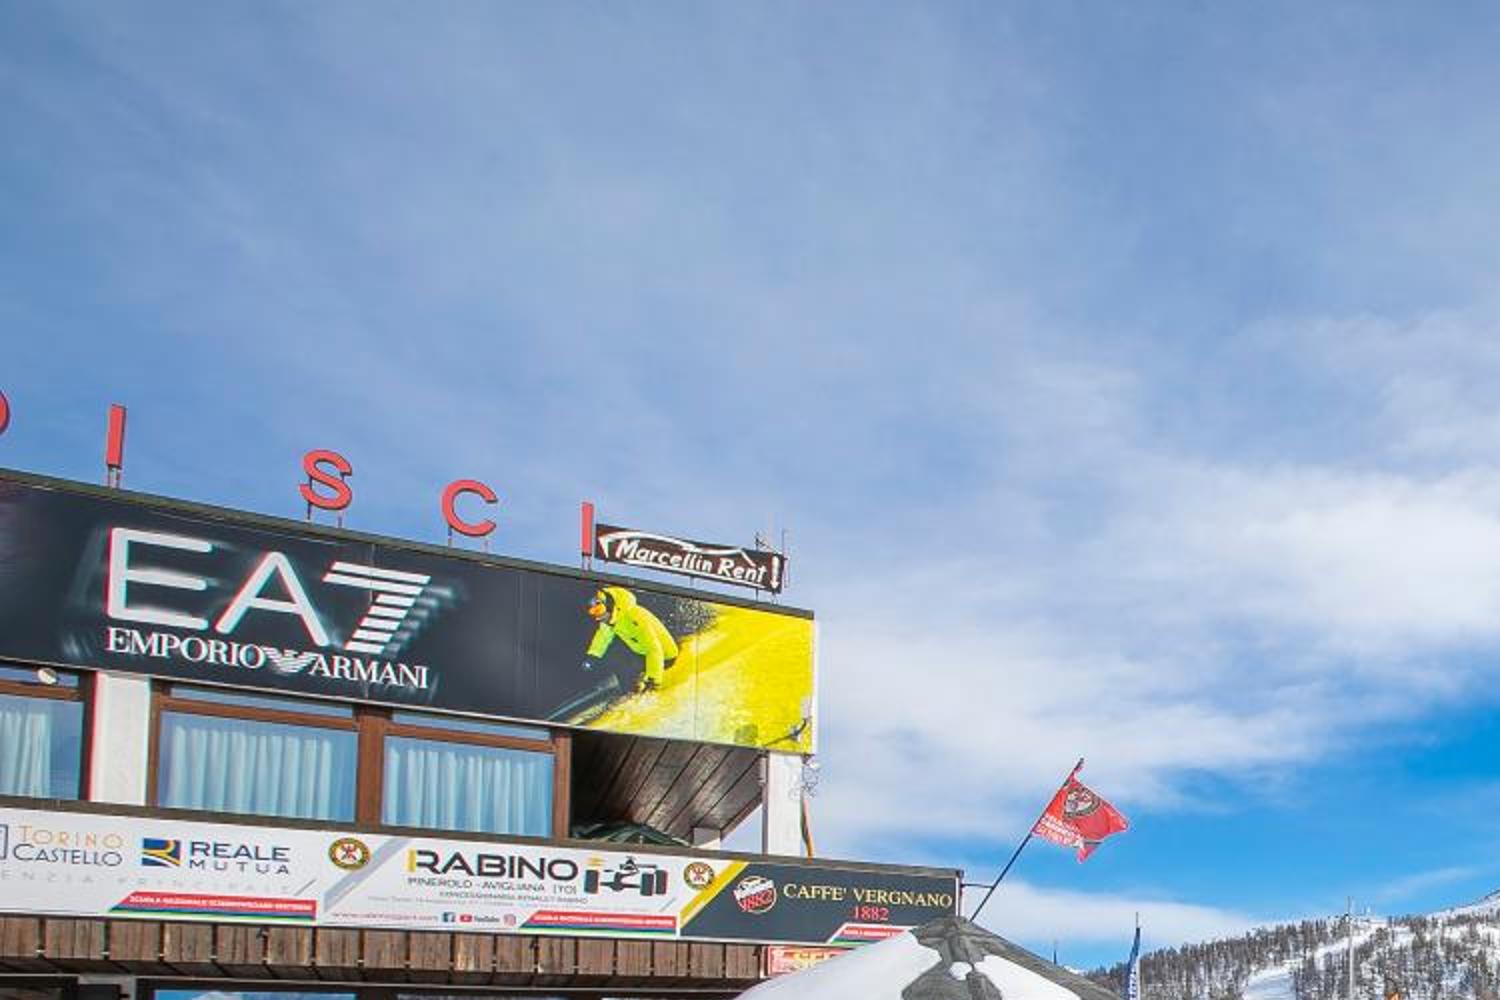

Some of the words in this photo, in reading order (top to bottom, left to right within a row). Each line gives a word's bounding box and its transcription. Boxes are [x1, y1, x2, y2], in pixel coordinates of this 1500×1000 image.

[615, 539, 713, 572] Marcellin
[717, 557, 767, 582] Rent
[107, 527, 432, 655] EA7
[106, 626, 267, 669] EMPORIO
[310, 652, 429, 689] ARMANI
[18, 825, 123, 849] TORINO
[13, 843, 123, 868] CASTELLO
[190, 841, 291, 863] REALE
[189, 859, 290, 875] MUTUA
[405, 849, 579, 881] RABINO
[408, 877, 473, 889] PINEROLO
[783, 883, 847, 902] CAFFE'
[853, 888, 953, 908] VERGNANO
[853, 906, 889, 921] 1882
